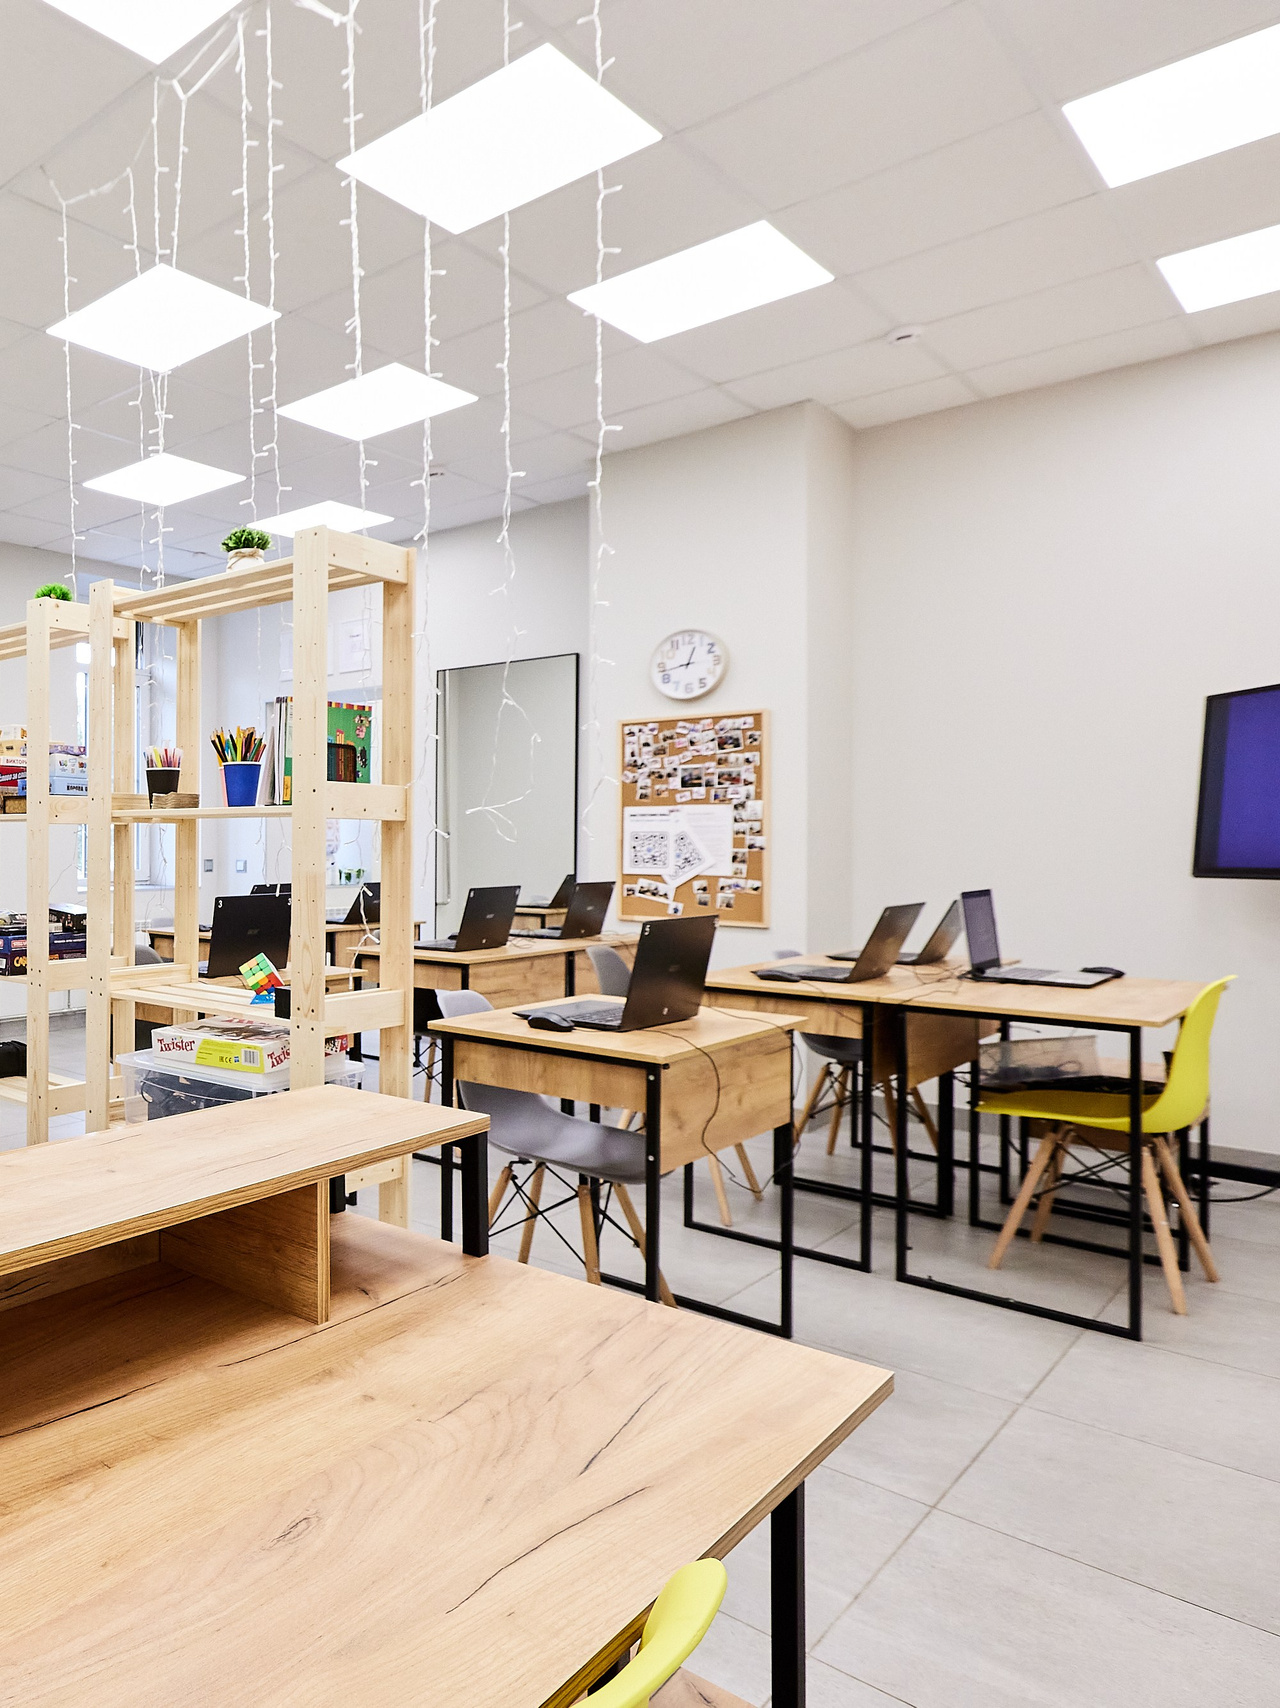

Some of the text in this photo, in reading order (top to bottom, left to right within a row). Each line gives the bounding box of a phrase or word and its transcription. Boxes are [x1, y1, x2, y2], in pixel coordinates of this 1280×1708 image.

[671, 639, 679, 650] 11
[681, 633, 695, 646] 12
[707, 642, 716, 654] 2
[713, 654, 721, 666] 3
[661, 673, 671, 684] 8
[699, 677, 707, 689] 5
[672, 680, 681, 692] 7
[684, 682, 694, 694] 6
[218, 900, 223, 908] 3
[644, 924, 651, 936] 5
[157, 1036, 196, 1053] Twister
